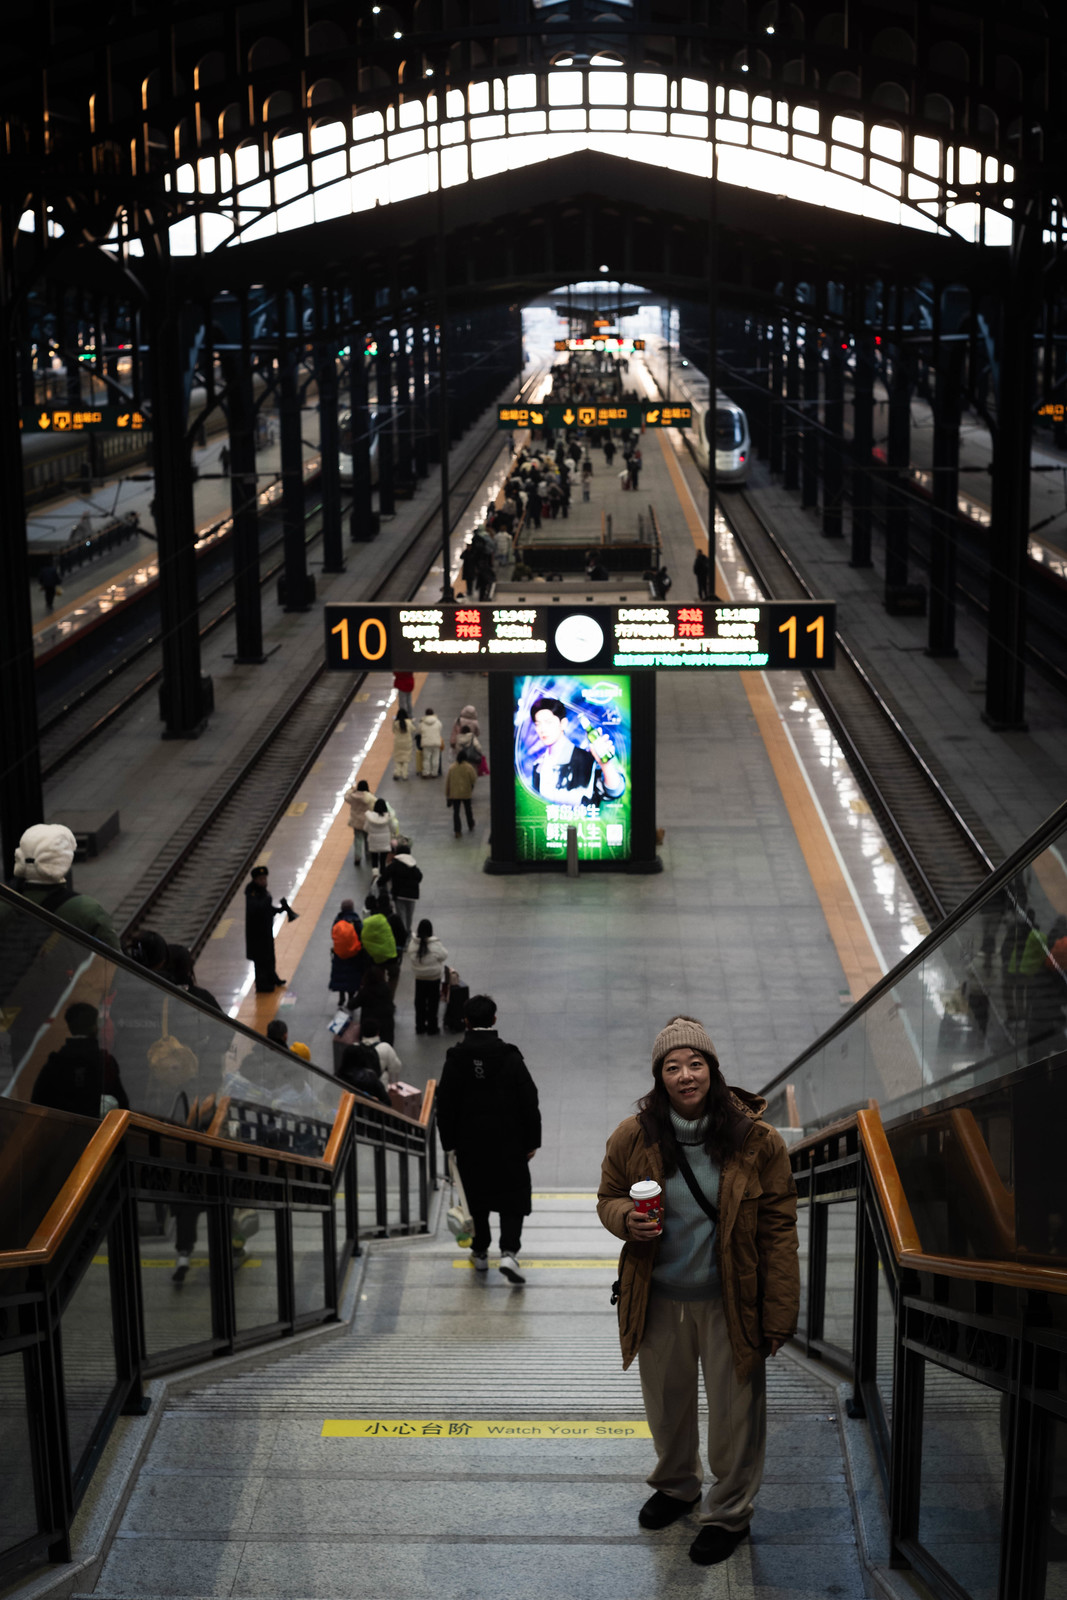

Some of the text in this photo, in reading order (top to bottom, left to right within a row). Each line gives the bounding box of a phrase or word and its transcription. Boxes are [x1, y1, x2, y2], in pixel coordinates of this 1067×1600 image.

[455, 609, 480, 624] 本站
[677, 608, 704, 623] 本站
[455, 624, 482, 638] 开往
[678, 623, 705, 637] 开往
[778, 615, 825, 659] 11
[331, 618, 387, 661] 10
[546, 804, 601, 821] 青岛纯生
[365, 1422, 635, 1436] 小心台阶 Watch Your Step
